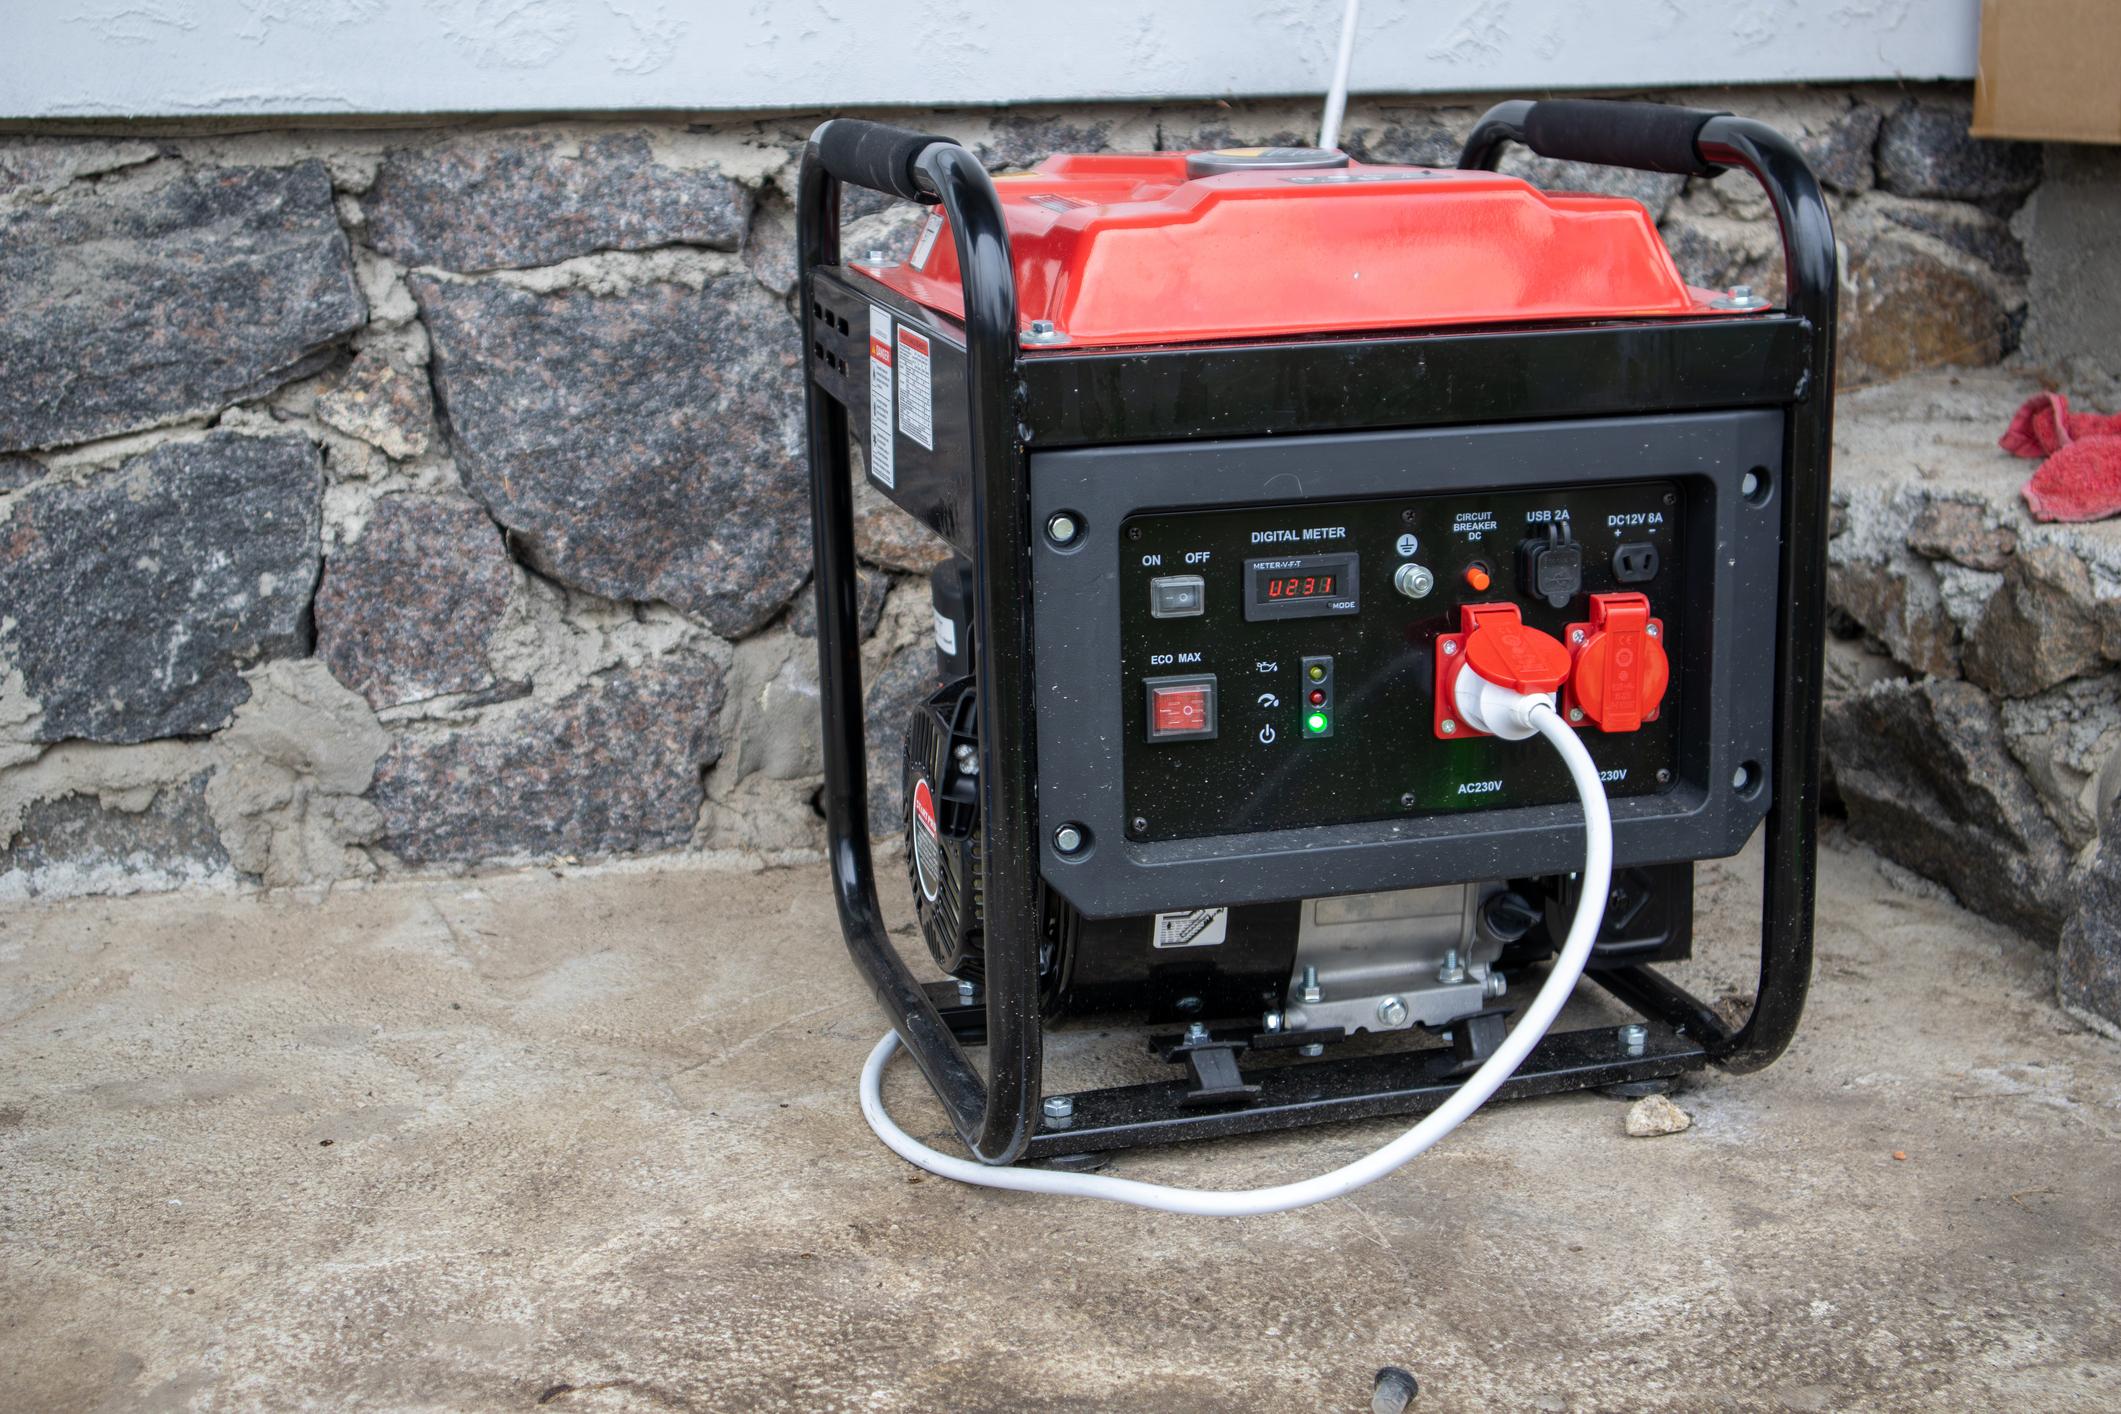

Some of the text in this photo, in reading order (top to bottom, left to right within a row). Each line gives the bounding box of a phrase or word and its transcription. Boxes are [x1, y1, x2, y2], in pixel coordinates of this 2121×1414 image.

[1456, 511, 1492, 522] CIRCUIT
[1527, 509, 1570, 523] USB 2A
[1608, 511, 1663, 526] DC12V 8A
[1453, 521, 1497, 532] BREAKER
[1251, 527, 1346, 543] DIGITAL METER
[1468, 531, 1482, 541] DC
[1142, 554, 1161, 566] ON
[1185, 551, 1210, 564] OFF
[1268, 576, 1333, 597] U231
[1332, 601, 1356, 610] MODE
[1151, 652, 1201, 665] ECO MAX
[1599, 769, 1627, 781] 230V
[1458, 780, 1502, 794] AC230V
